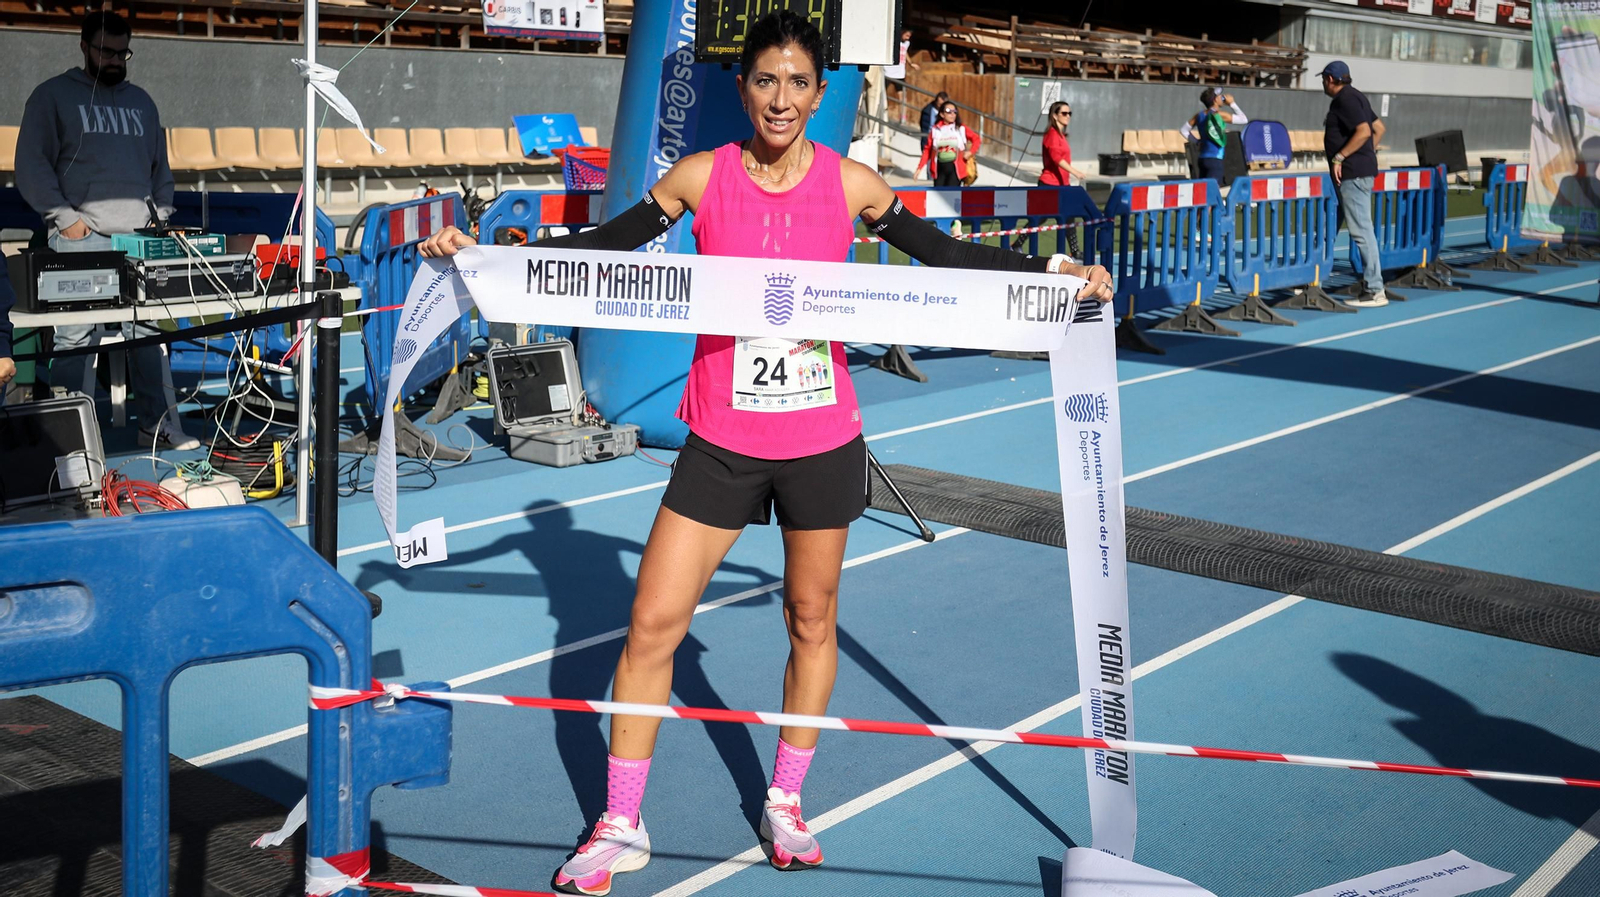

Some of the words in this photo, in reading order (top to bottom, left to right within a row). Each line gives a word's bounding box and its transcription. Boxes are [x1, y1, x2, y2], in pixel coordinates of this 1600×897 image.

[78, 104, 144, 137] LEVI'S
[403, 265, 457, 331] Ayuntamiento
[526, 258, 589, 298] MEDIA
[596, 262, 692, 303] MARATON
[803, 286, 900, 303] Ayuntamiento
[903, 291, 920, 302] de
[922, 292, 958, 306] Jerez
[411, 293, 446, 332] Deportes
[595, 300, 638, 318] CIUDAD
[640, 302, 654, 319] DE
[655, 303, 690, 321] JEREZ
[802, 301, 856, 316] Deportes
[1006, 284, 1069, 323] MEDIA
[753, 357, 788, 389] 24
[1079, 430, 1091, 481] Deportes
[1090, 430, 1106, 523] Ayuntamiento
[1099, 525, 1109, 541] de
[1099, 543, 1110, 578] Jerez
[1097, 623, 1125, 686] MEDIA
[1089, 688, 1103, 729] CIUDAD
[1102, 689, 1129, 786] MARTON
[1369, 873, 1434, 896] Ayuntamiento
[1432, 870, 1445, 880] de
[1445, 864, 1470, 880] Jerez
